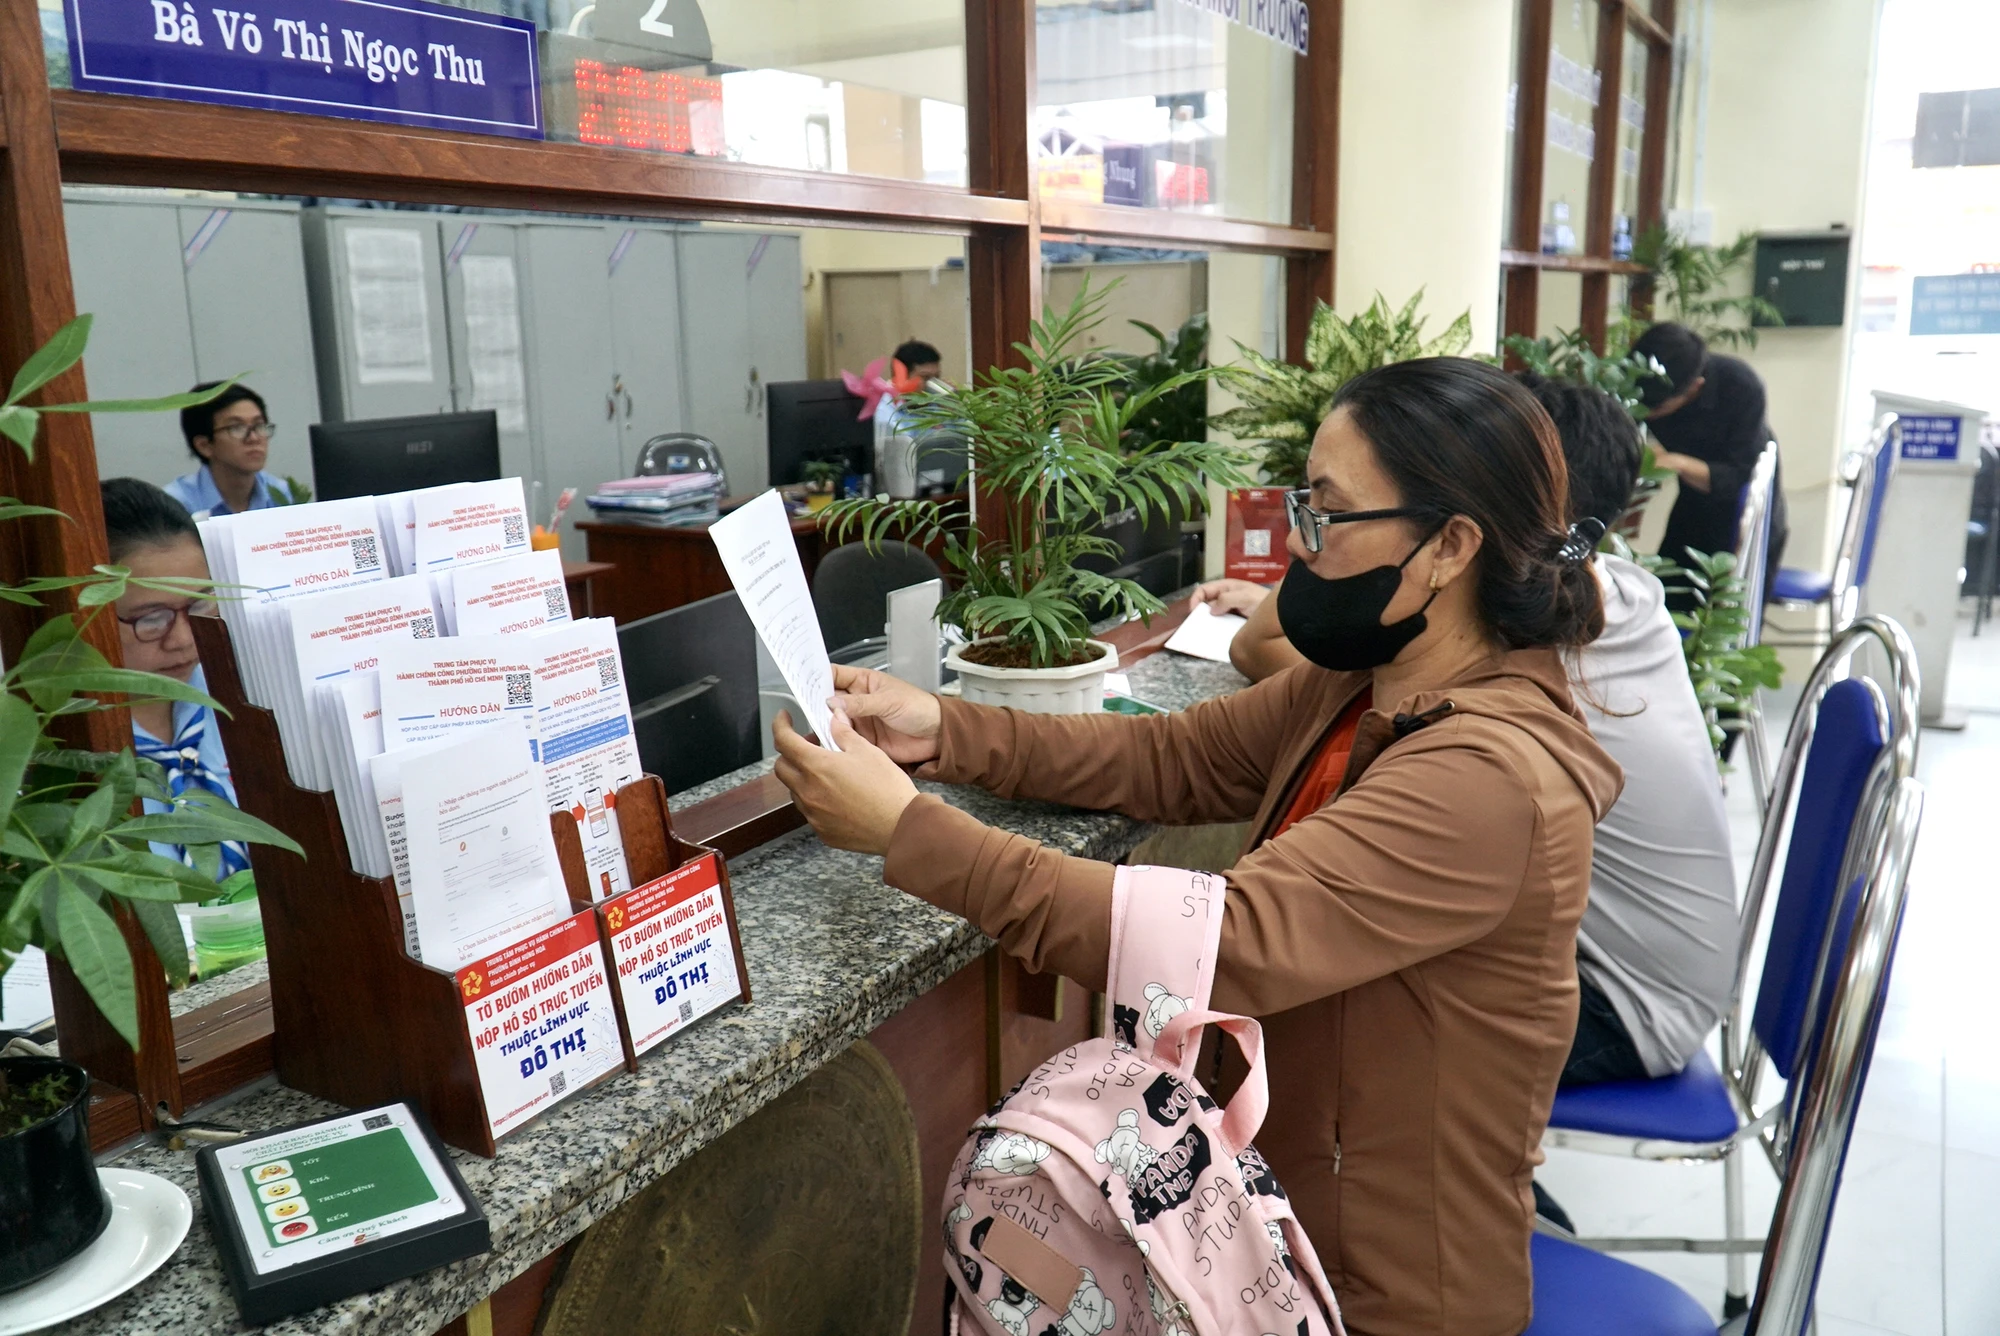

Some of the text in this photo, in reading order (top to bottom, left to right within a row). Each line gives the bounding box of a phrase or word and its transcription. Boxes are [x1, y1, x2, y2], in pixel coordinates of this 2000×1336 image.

[153, 0, 486, 86] Bà Võ Thị Ngọc Thu
[285, 529, 304, 538] TRUNG
[306, 528, 317, 536] TÂM
[318, 526, 333, 535] PHỤC
[251, 544, 268, 552] HÀNH
[269, 541, 288, 550] CHÍNH
[281, 549, 301, 557] THÀNH
[302, 545, 313, 554] PHỐ
[324, 542, 333, 550] CHÍ
[456, 544, 501, 559] HƯỚNG DẪN
[294, 569, 350, 587] HƯỚNG DẪN
[377, 608, 392, 617] PHỤC
[310, 631, 328, 639] HÀNH
[329, 627, 347, 636] CHÍNH
[348, 622, 364, 630] CÔNG
[365, 616, 388, 628] PHƯỜNG
[390, 614, 403, 622] BÌNH
[340, 632, 360, 641] THÀNH
[362, 628, 373, 638] PHỐ
[384, 624, 393, 632] CHÍ
[500, 617, 544, 635] HƯỚNG DẪN
[451, 676, 463, 684] PHỐ
[553, 687, 597, 707] HƯỚNG DẪN
[440, 703, 500, 717] HƯỚNG DẪN
[626, 893, 640, 904] TRUNG
[640, 889, 649, 897] TÂM
[649, 883, 660, 893] PHỤC
[666, 875, 678, 884] HÀNH
[678, 869, 690, 879] CHÍNH
[690, 864, 700, 873] CÔNG
[628, 900, 644, 913] PHƯỜNG
[645, 896, 654, 904] BÌNH
[655, 890, 666, 899] HƯNG
[619, 893, 714, 952] TỜ BƯỚM HƯỚNG DẪN
[486, 955, 503, 967] TRUNG
[503, 949, 514, 959] TÂM
[514, 943, 528, 954] PHỤC
[535, 933, 549, 944] HÀNH
[549, 926, 564, 937] CHÍNH
[564, 920, 577, 930] CÔNG
[618, 910, 723, 978] NỘP HỒ SƠ TRỰC TUYẾN
[488, 963, 508, 977] PHƯỜNG
[509, 957, 521, 967] BÌNH
[522, 950, 535, 961] HƯNG
[639, 938, 712, 984] THUỘC LĨNH VỰC
[476, 951, 593, 1022] TỜ BƯỚM HƯỚNG DẪN
[490, 977, 503, 987] Hành
[504, 970, 517, 980] chính
[518, 965, 529, 975] phục
[654, 962, 709, 1005] ĐÔ THỊ
[475, 971, 603, 1050] NỘP HỒ SƠ TRỰC TUYẾN
[500, 1001, 590, 1056] THUỘC LĨNH VỰC
[520, 1028, 587, 1078] ĐÔ THỊ
[302, 1156, 321, 1166] TỐT
[1135, 1133, 1198, 1199] PANDA
[309, 1175, 330, 1185] KHÁ
[317, 1182, 376, 1203] TRUNG BÌNH
[326, 1212, 349, 1223] KÉM
[357, 1224, 376, 1233] Quý
[379, 1215, 408, 1227] Khách
